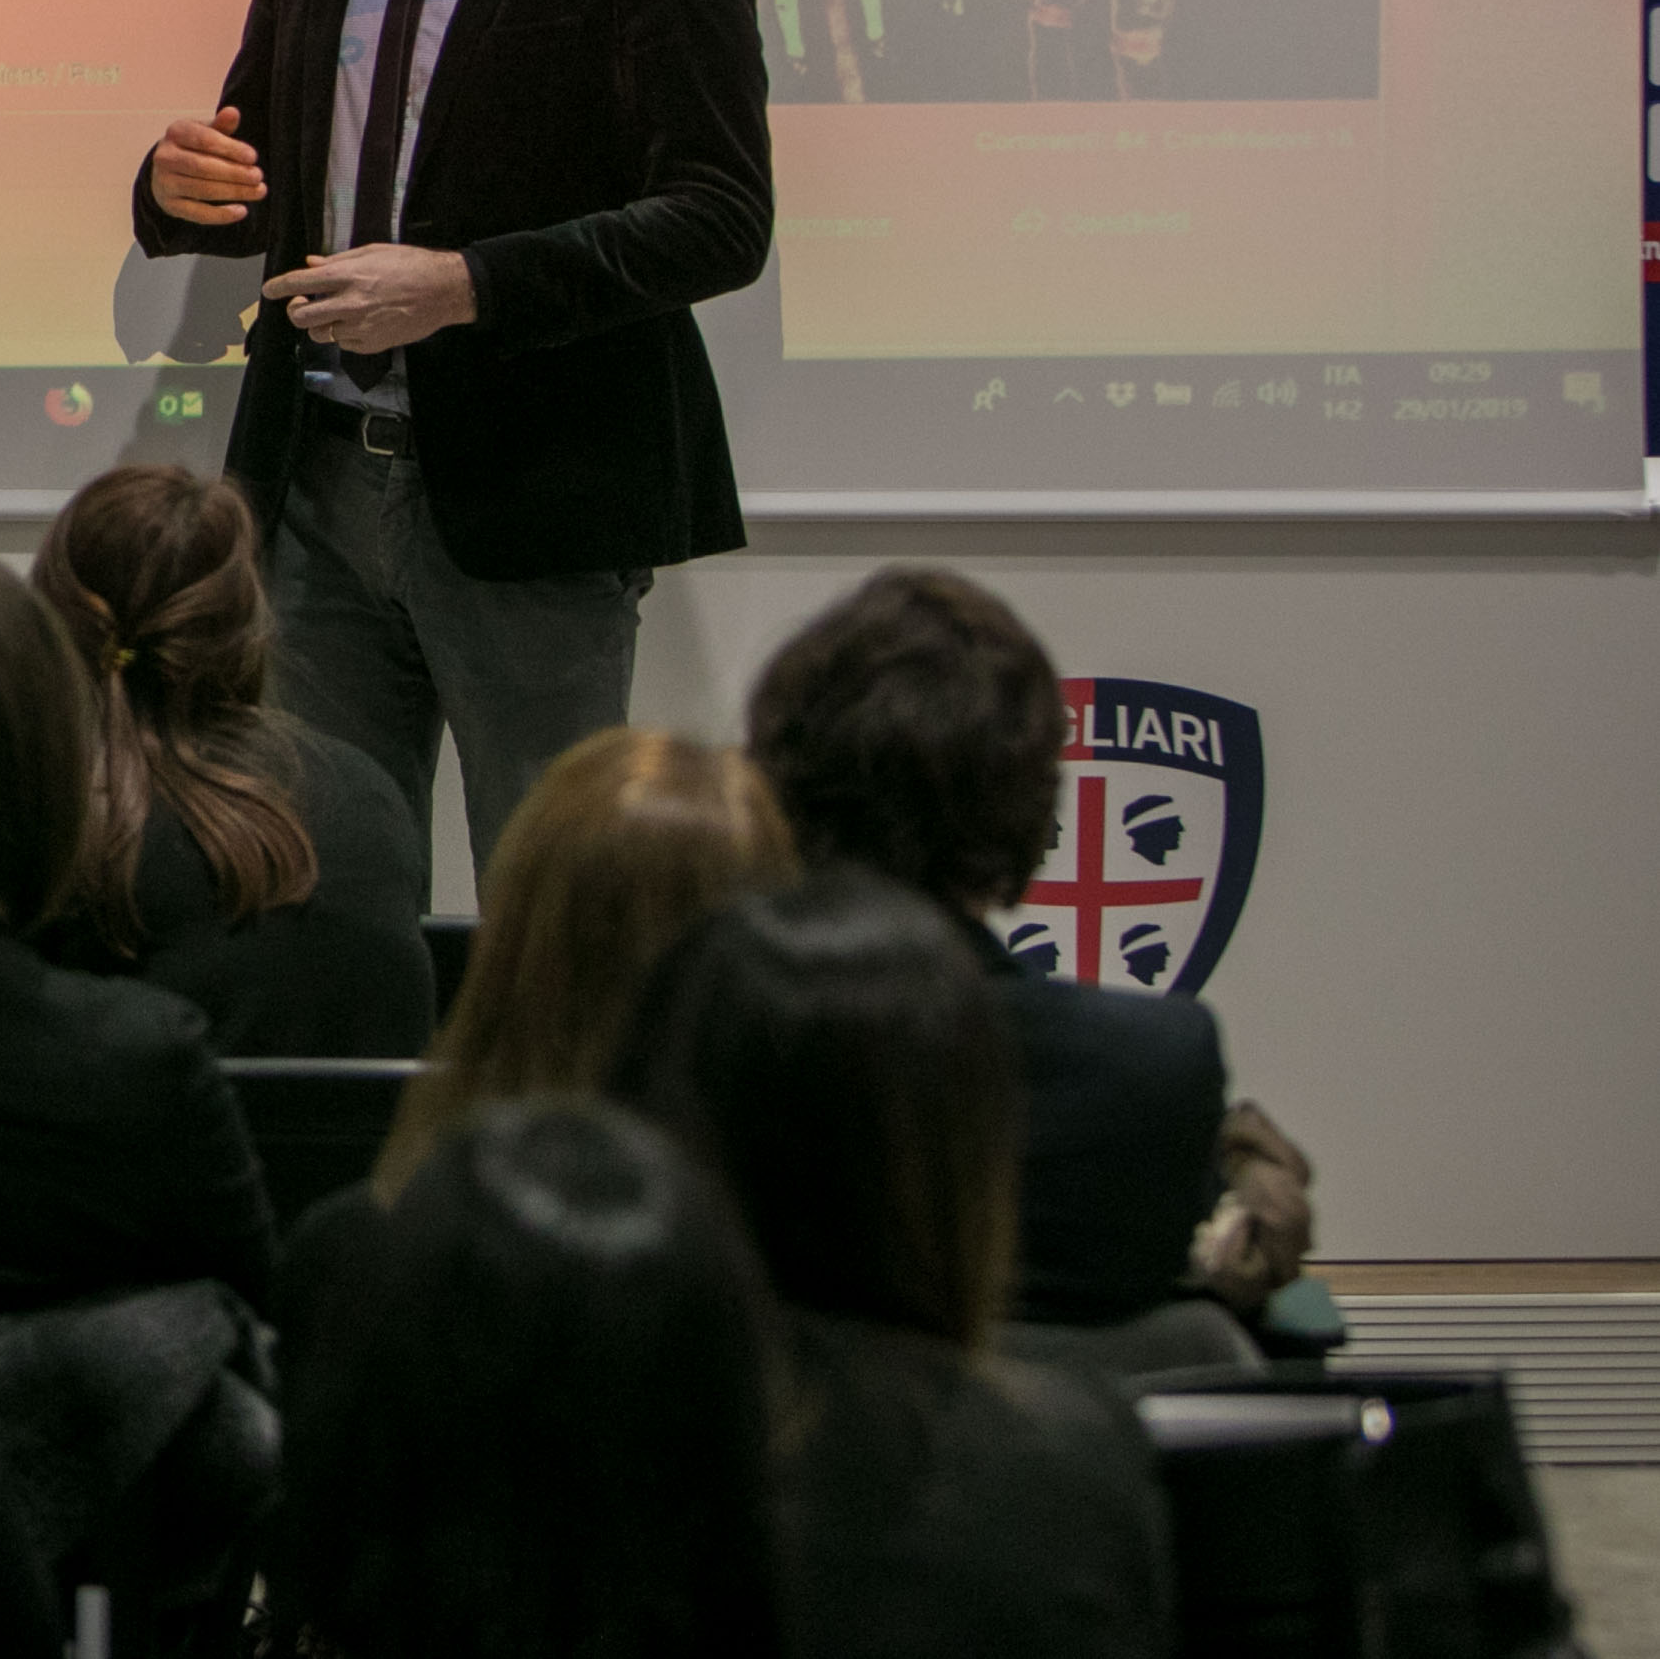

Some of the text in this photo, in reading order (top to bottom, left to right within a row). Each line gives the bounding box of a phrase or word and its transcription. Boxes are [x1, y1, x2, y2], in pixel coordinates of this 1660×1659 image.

[1323, 363, 1363, 386] ITA
[1393, 396, 1529, 422] 29/01/2019
[1061, 703, 1224, 767] LIARI
